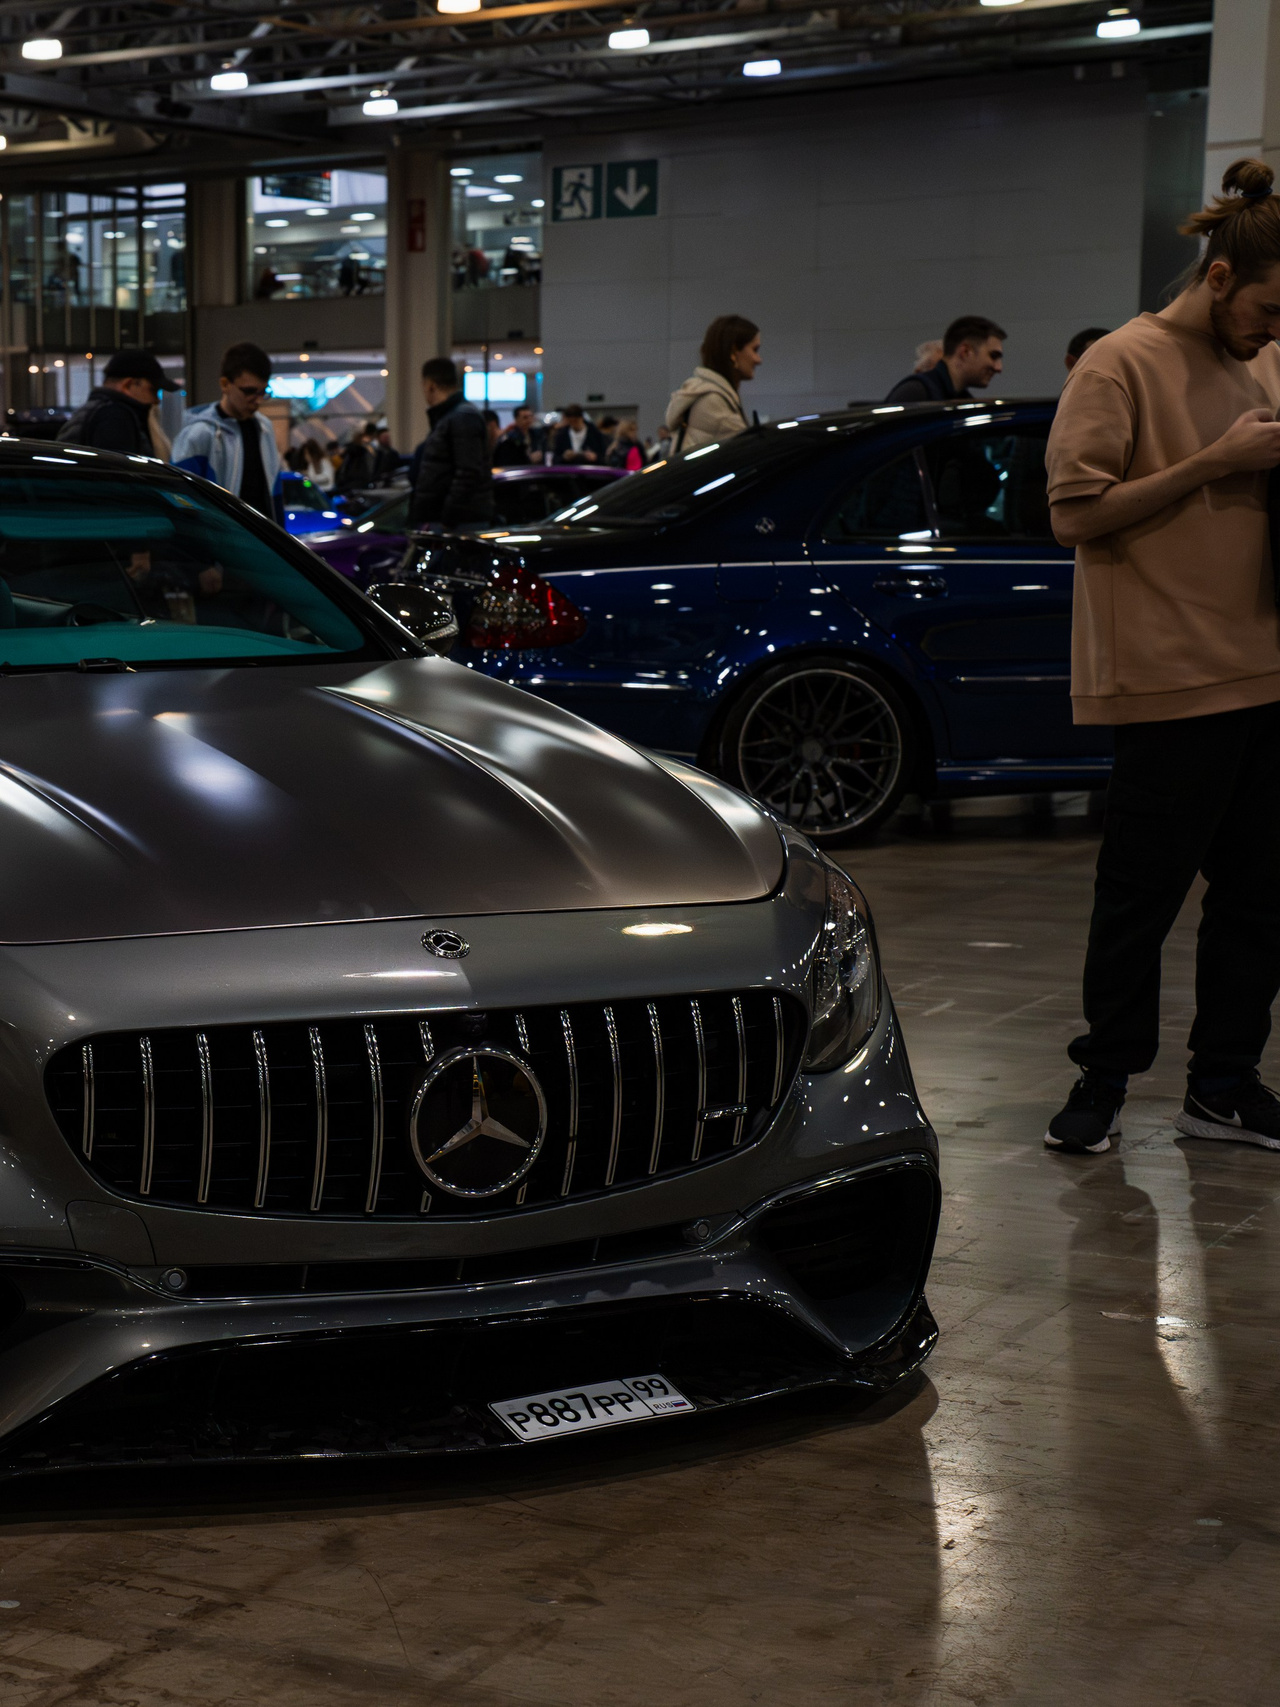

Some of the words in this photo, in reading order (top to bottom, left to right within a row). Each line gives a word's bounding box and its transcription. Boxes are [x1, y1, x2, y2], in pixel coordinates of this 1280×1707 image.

[507, 1391, 634, 1433] P887PP
[632, 1378, 669, 1398] 99
[653, 1401, 673, 1411] RUS
